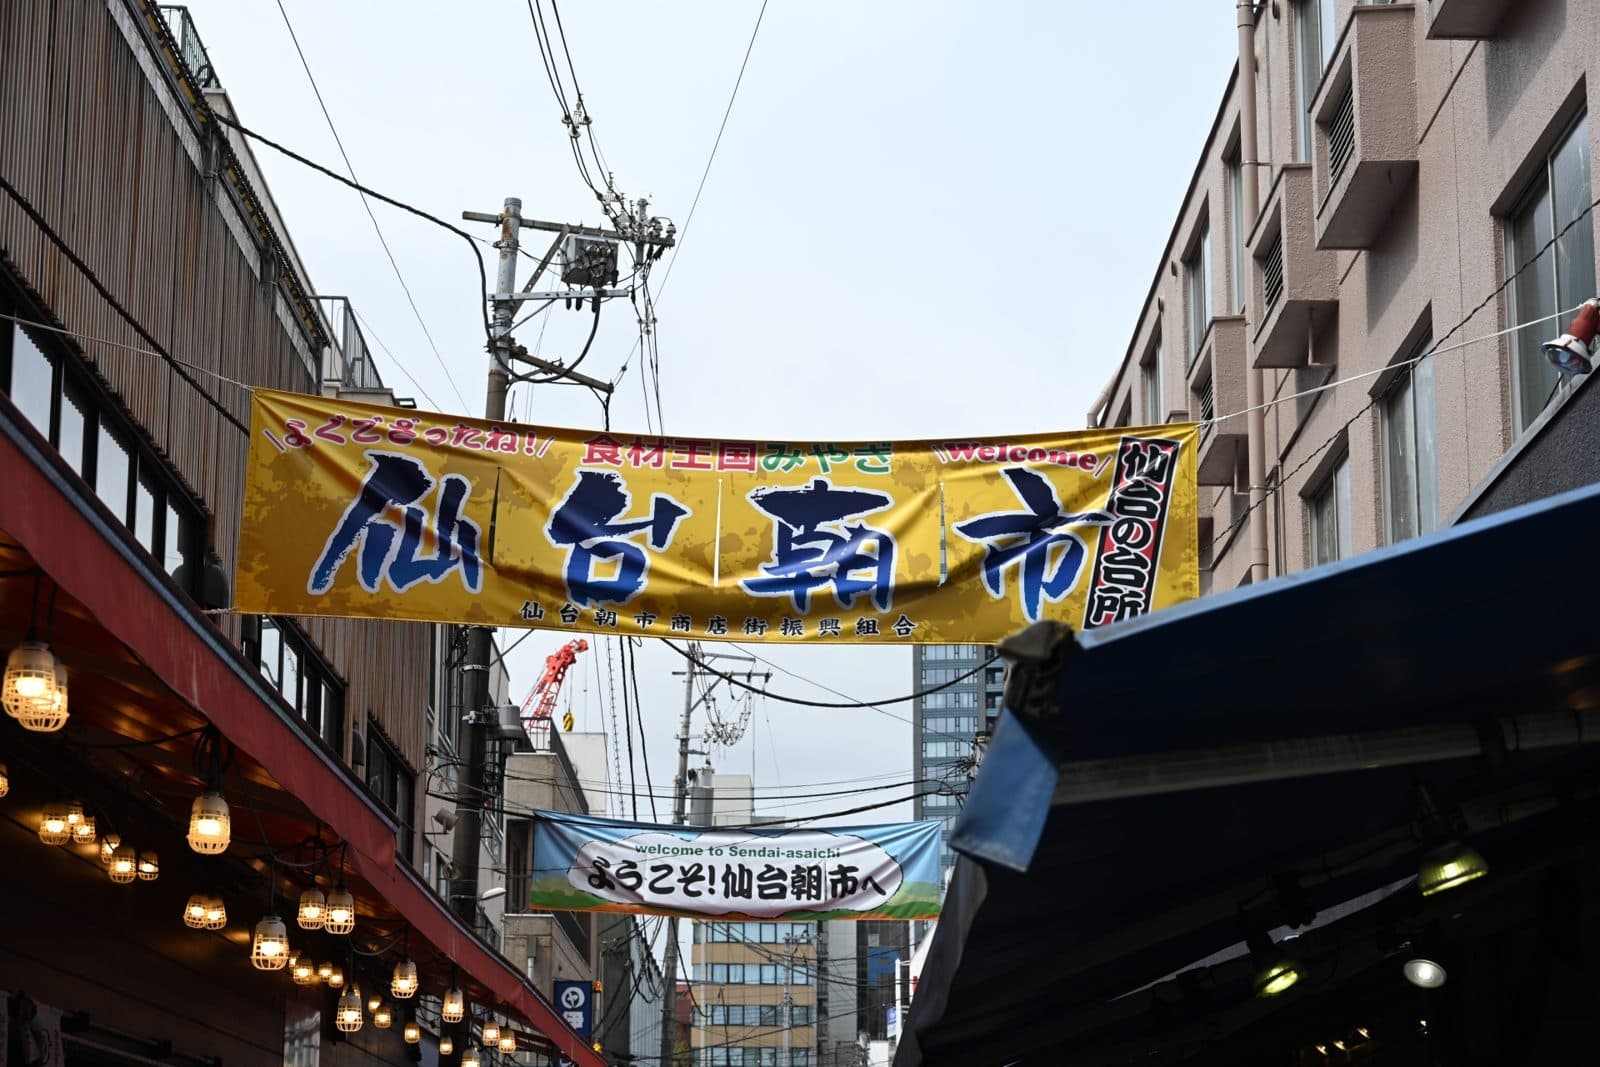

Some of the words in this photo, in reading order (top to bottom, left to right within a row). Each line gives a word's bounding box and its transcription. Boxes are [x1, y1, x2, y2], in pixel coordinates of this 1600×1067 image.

[582, 434, 893, 473] 食材王国みやぎ
[944, 442, 1098, 471] Welcome
[308, 452, 1114, 624] 仙台朝市
[1091, 443, 1170, 623] 仙台の台所
[521, 600, 917, 637] 仙台朝市商店街振興組合
[635, 844, 703, 856] welcome
[709, 846, 724, 857] to
[729, 846, 840, 858] Sendai-asaichi
